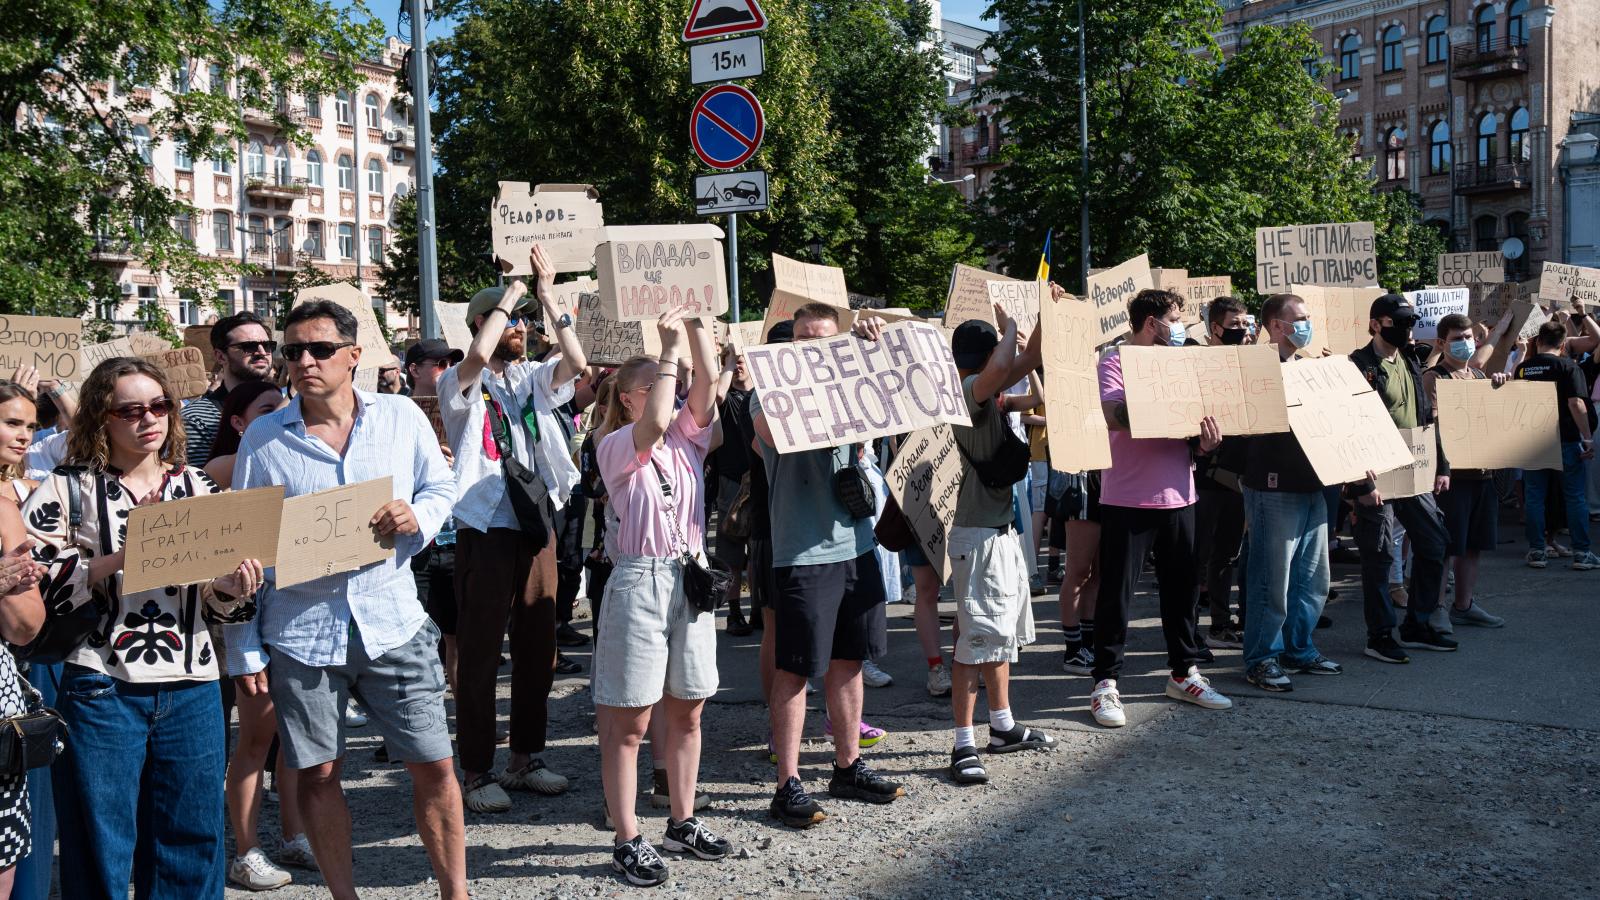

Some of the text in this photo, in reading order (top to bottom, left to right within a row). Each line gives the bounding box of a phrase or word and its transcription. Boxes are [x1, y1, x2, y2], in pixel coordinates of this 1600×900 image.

[1262, 230, 1292, 258] НЕ
[1258, 262, 1280, 289] ТЕ
[1312, 258, 1375, 284] ПРАЦЮЄ
[1443, 252, 1504, 270] LET HIM
[1545, 265, 1580, 277] ДОСИТЬ
[644, 270, 662, 284] ЦЕ
[1442, 269, 1483, 286] COOK
[34, 352, 76, 378] МО
[747, 322, 954, 390] ПОВЕРНІТЬ
[762, 362, 970, 447] ФЕДОРОВА
[140, 521, 244, 552] ГРАТИ НА
